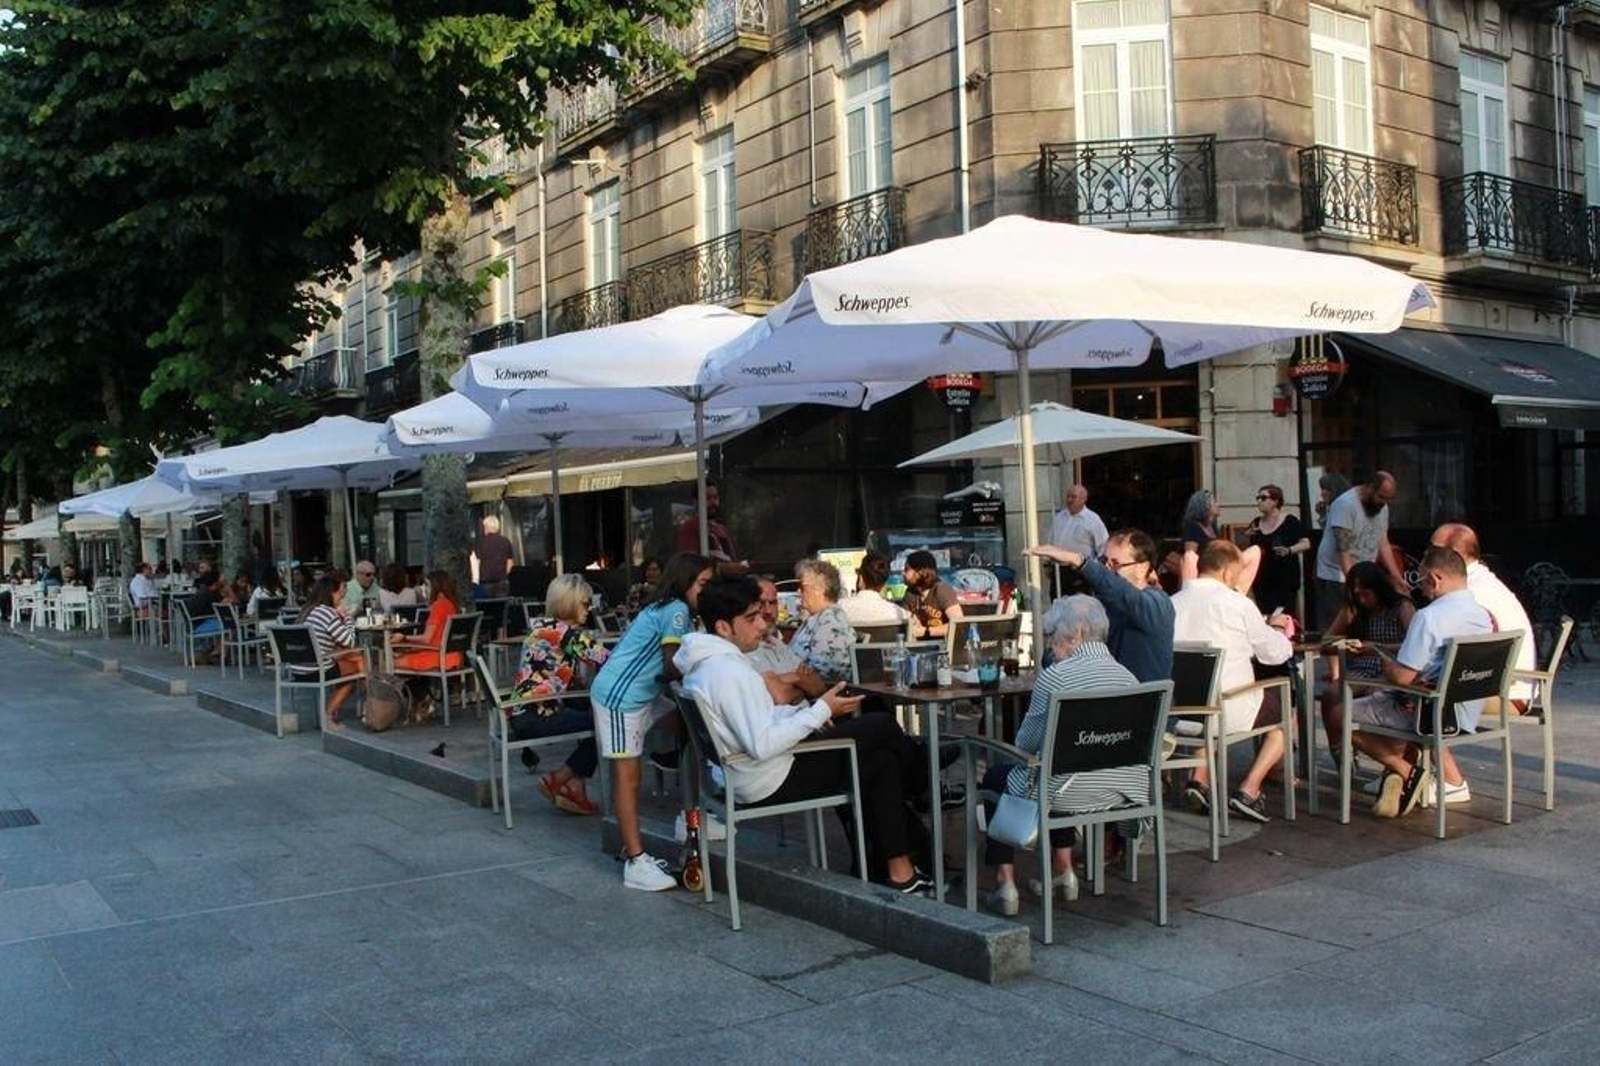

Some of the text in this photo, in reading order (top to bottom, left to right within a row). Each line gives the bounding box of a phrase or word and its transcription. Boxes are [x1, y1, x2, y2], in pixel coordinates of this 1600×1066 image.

[834, 294, 911, 313] Schweppes
[1305, 301, 1375, 324] Schweppes
[494, 368, 549, 381] Schweppes
[946, 377, 974, 386] BODEGA
[1074, 730, 1132, 746] Schweppes
